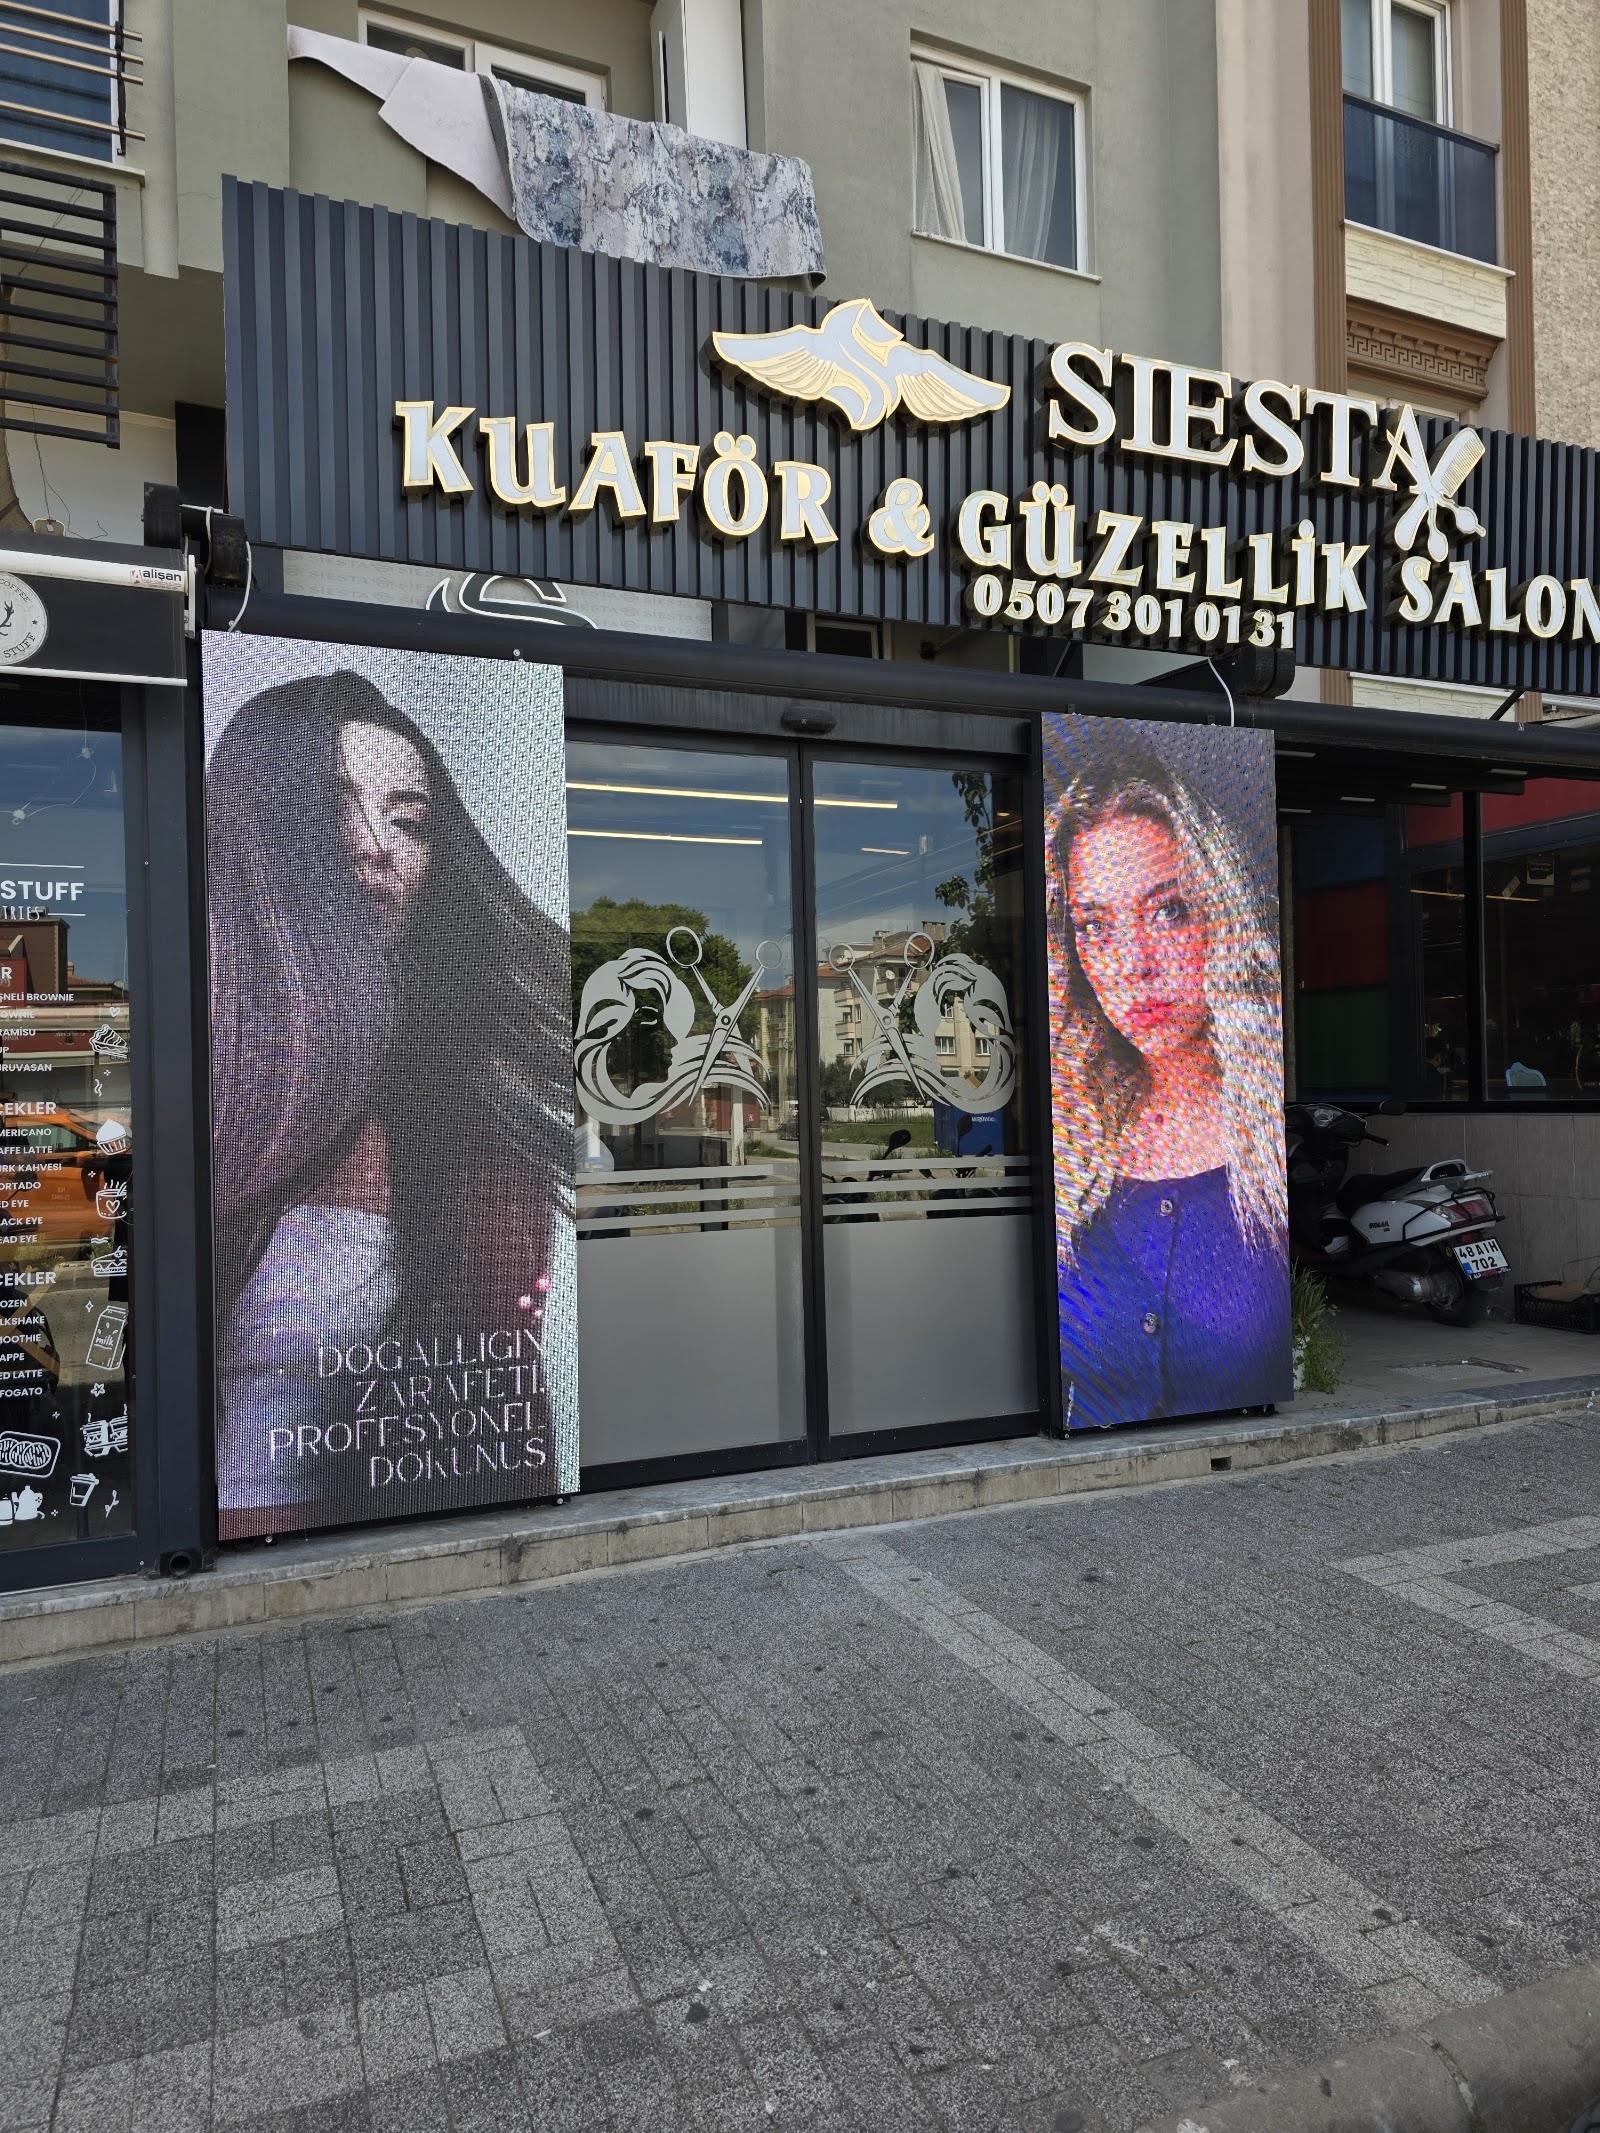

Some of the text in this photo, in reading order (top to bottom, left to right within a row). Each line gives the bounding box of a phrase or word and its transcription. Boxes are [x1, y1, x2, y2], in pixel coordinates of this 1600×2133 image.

[1049, 341, 1432, 493] SIESTA
[395, 400, 1600, 643] KUAFÖR & GÜZELLİK SALON
[142, 568, 182, 582] alişan
[973, 574, 1294, 649] 0507 301 01 31
[3, 632, 36, 659] STUFF
[0, 880, 85, 901] STUFF
[26, 993, 75, 1002] BROWNIE
[23, 1145, 53, 1154] LATTE
[11, 1199, 30, 1208] EYE
[25, 1216, 44, 1225] EYE
[20, 1234, 38, 1243] EYE
[1459, 1240, 1499, 1259] 48 AIH
[1471, 1256, 1498, 1271] 702
[95, 1335, 114, 1347] milk
[12, 1368, 43, 1379] LATTE
